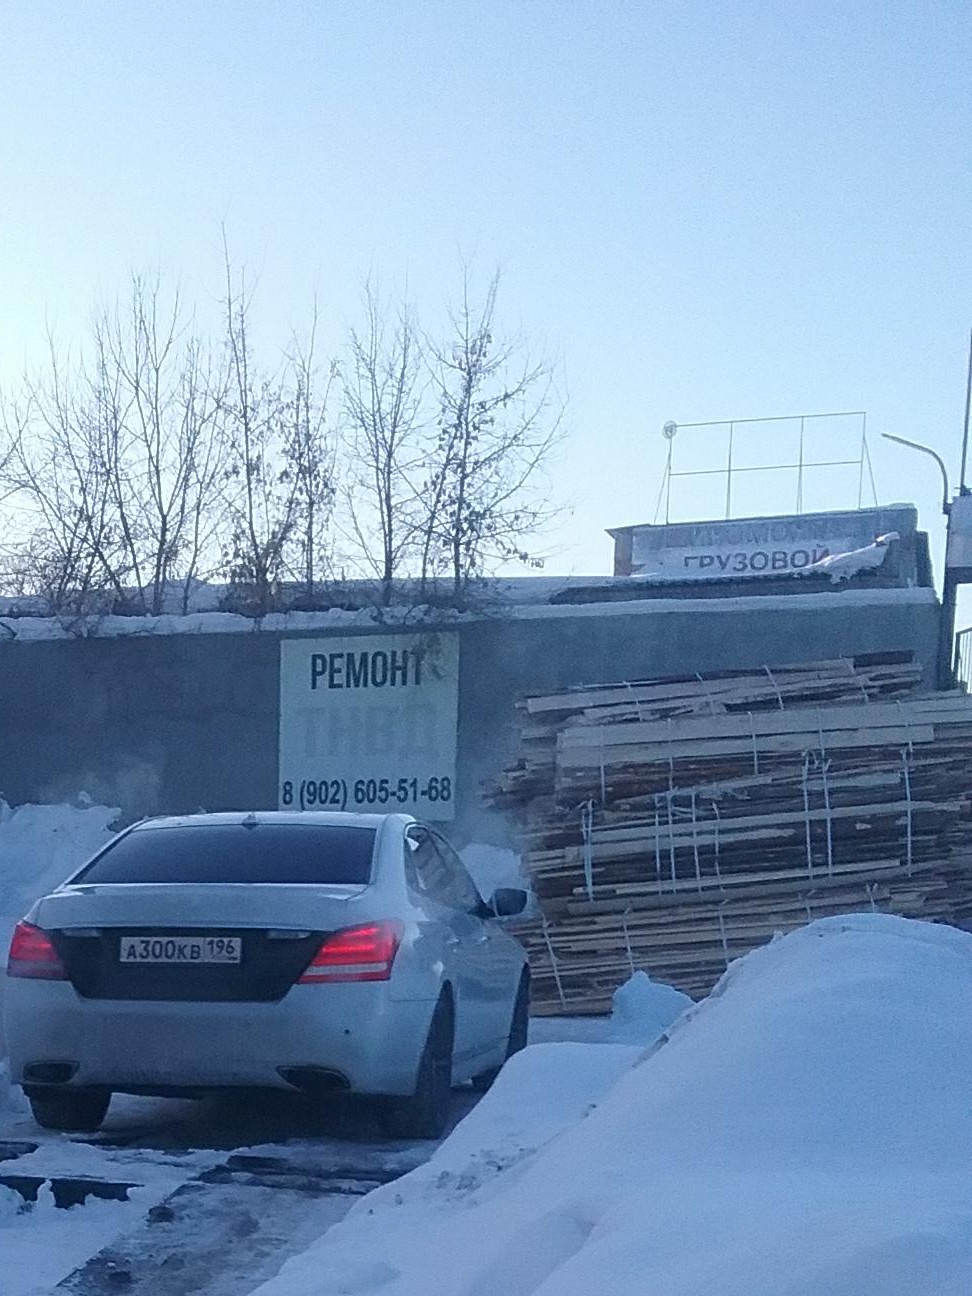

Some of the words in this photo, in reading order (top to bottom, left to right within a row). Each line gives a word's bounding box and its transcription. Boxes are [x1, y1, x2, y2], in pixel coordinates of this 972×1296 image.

[684, 544, 830, 572] ГРУЗОВОЙ
[311, 649, 425, 690] РЕМОНТ
[282, 780, 293, 805] 8
[299, 779, 348, 810] (902)
[354, 775, 452, 803] 605-51-68
[126, 939, 202, 960] А300КВ
[207, 939, 236, 955] 196
